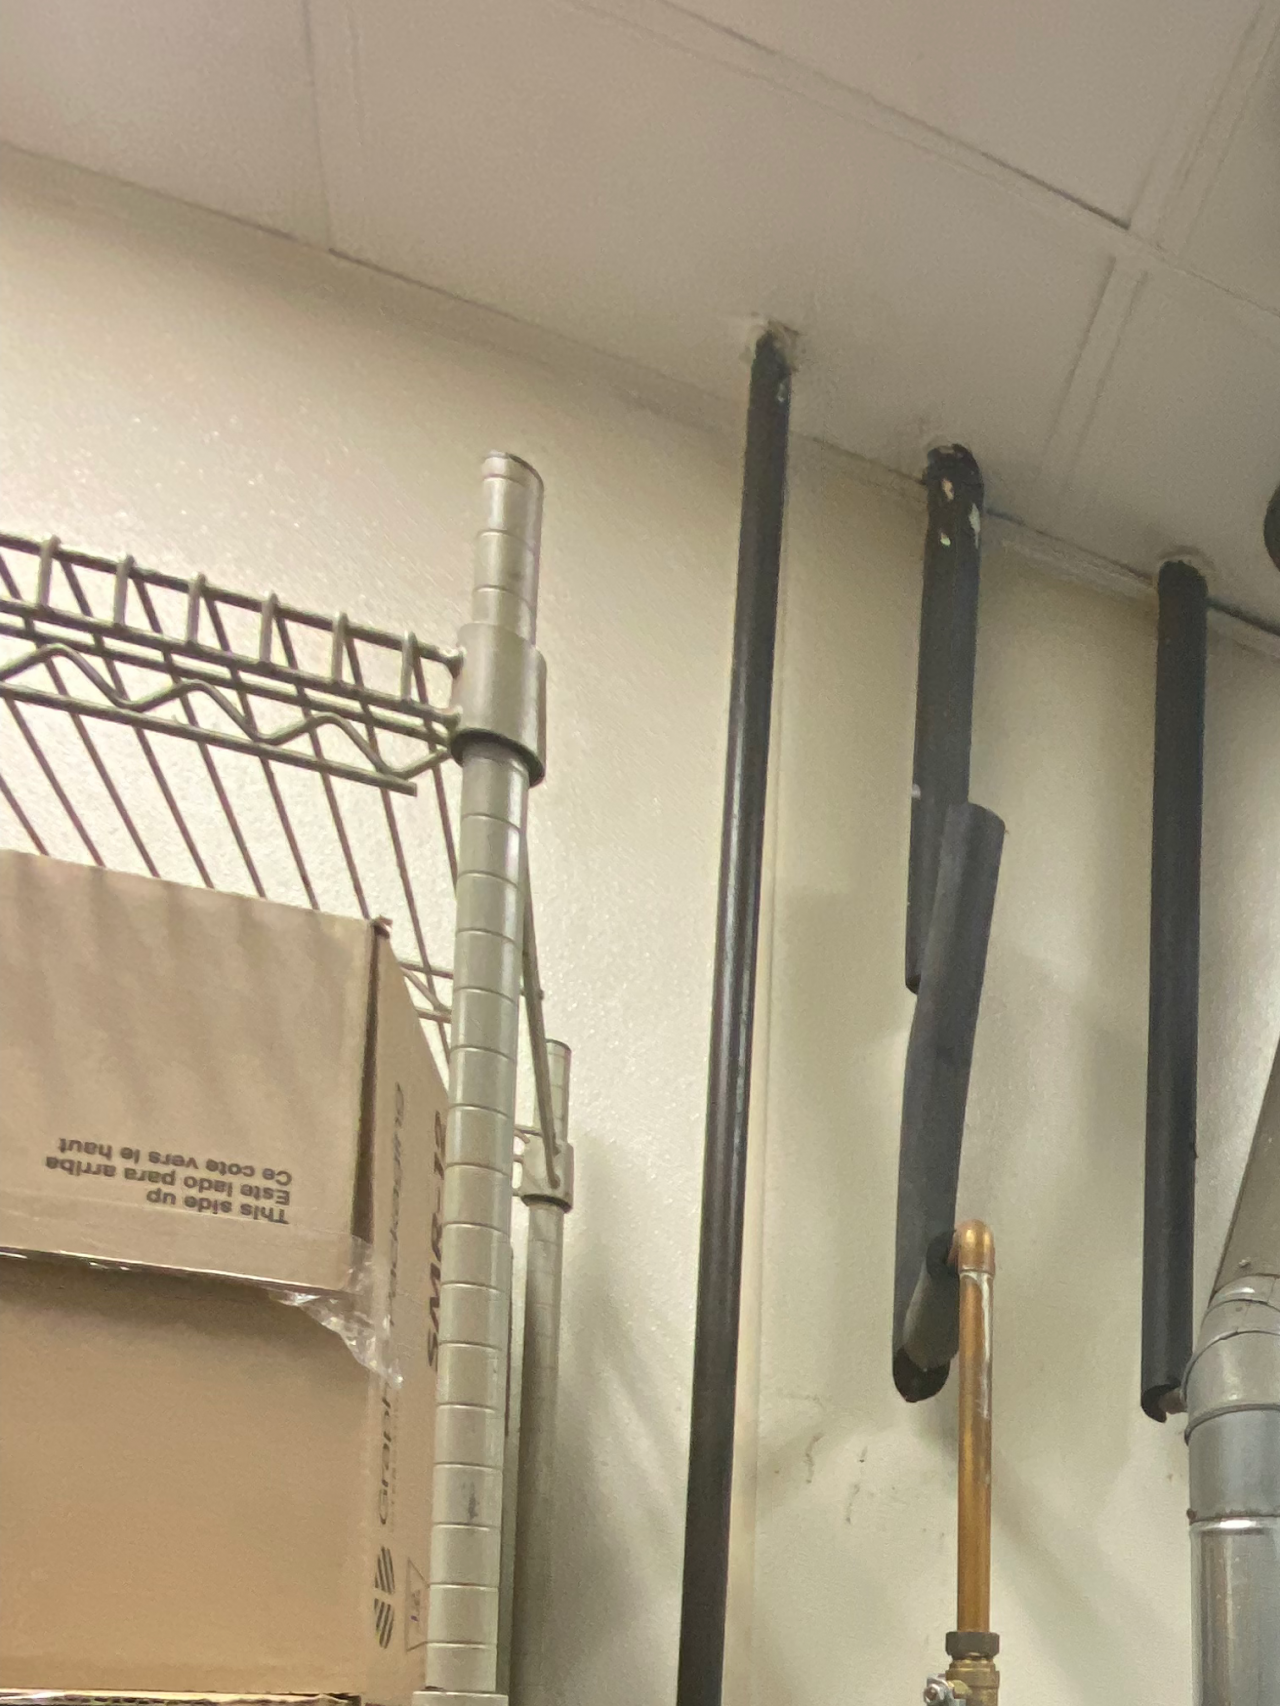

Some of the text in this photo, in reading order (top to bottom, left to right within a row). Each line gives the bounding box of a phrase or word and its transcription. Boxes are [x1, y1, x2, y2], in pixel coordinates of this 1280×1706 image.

[46, 1156, 290, 1205] Este lado para arriba
[58, 1138, 292, 1186] Ce cote vers le haut
[146, 1188, 290, 1225] This side up
